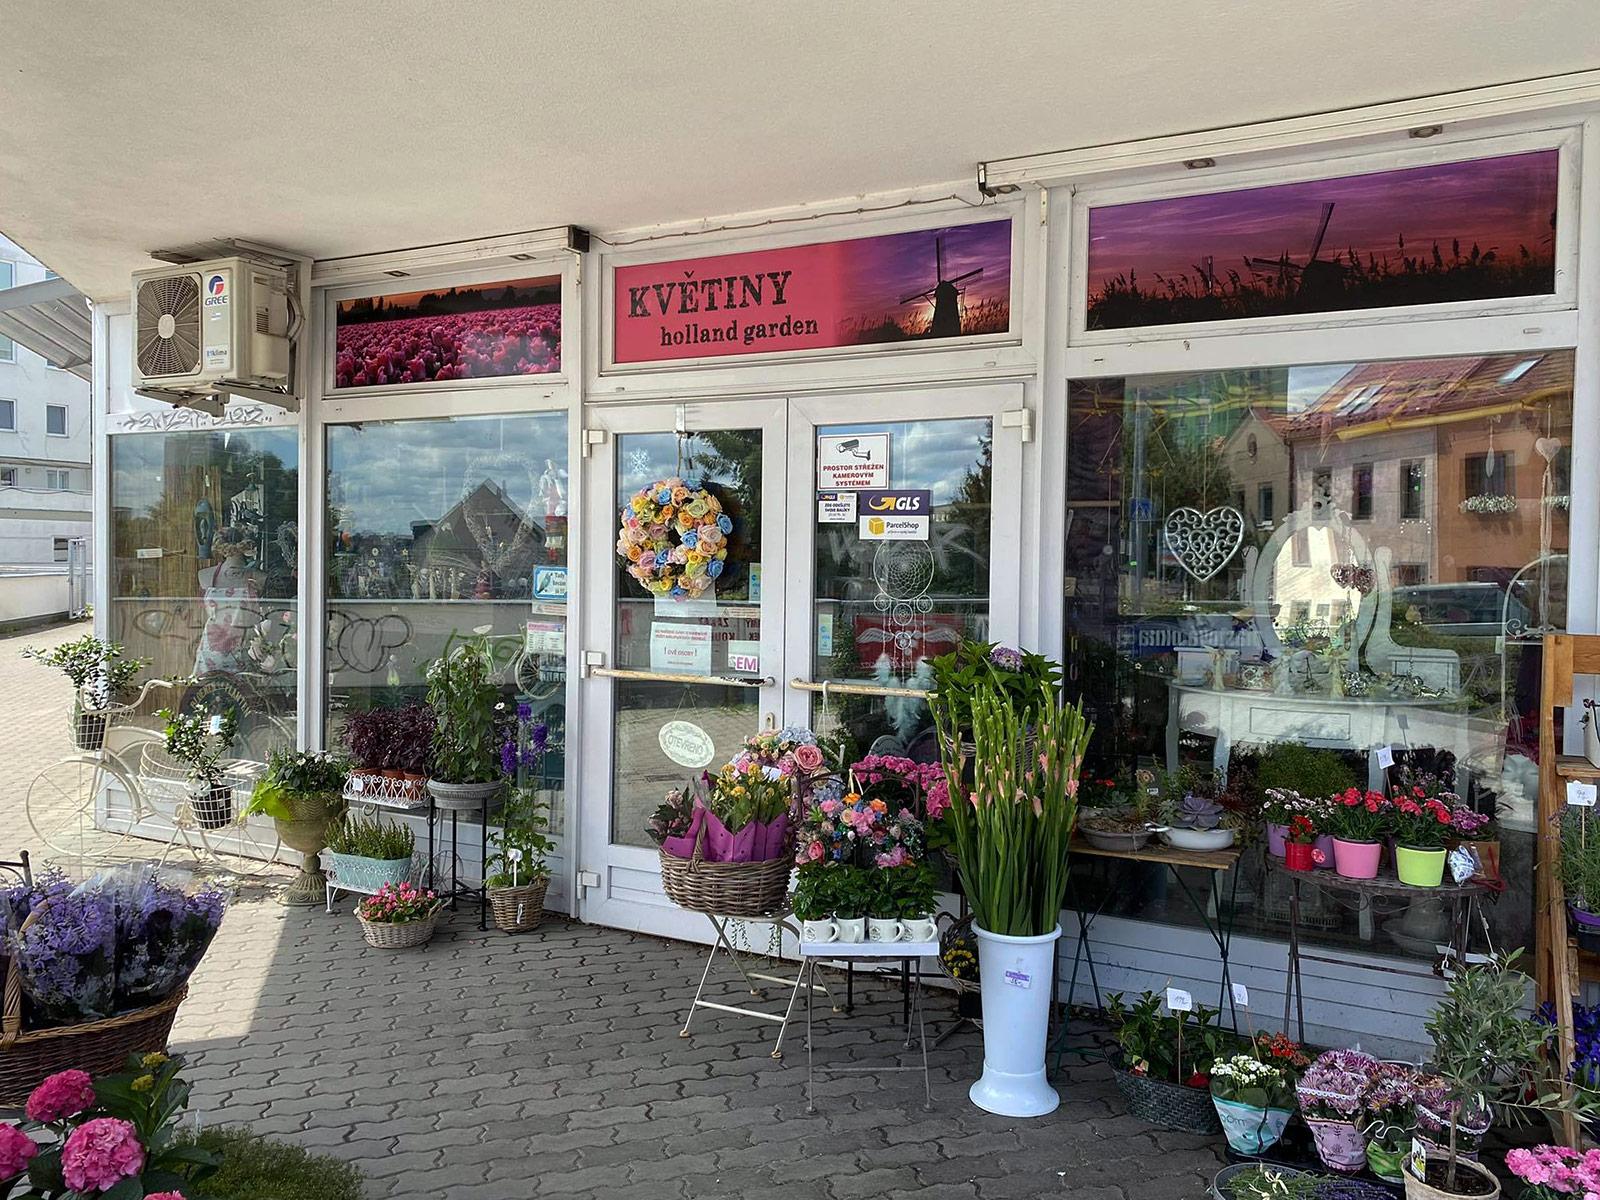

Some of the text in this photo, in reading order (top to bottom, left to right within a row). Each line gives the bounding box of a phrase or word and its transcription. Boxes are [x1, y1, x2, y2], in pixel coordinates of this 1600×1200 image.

[628, 270, 792, 318] KVĚTINY
[204, 295, 229, 306] GREE
[660, 315, 818, 346] holland garden
[854, 463, 884, 471] STŘEŽEN
[835, 479, 871, 487] SYSTÉMEM
[895, 497, 920, 510] GLS
[886, 521, 919, 530] ParcelShop
[728, 655, 757, 671] SEM
